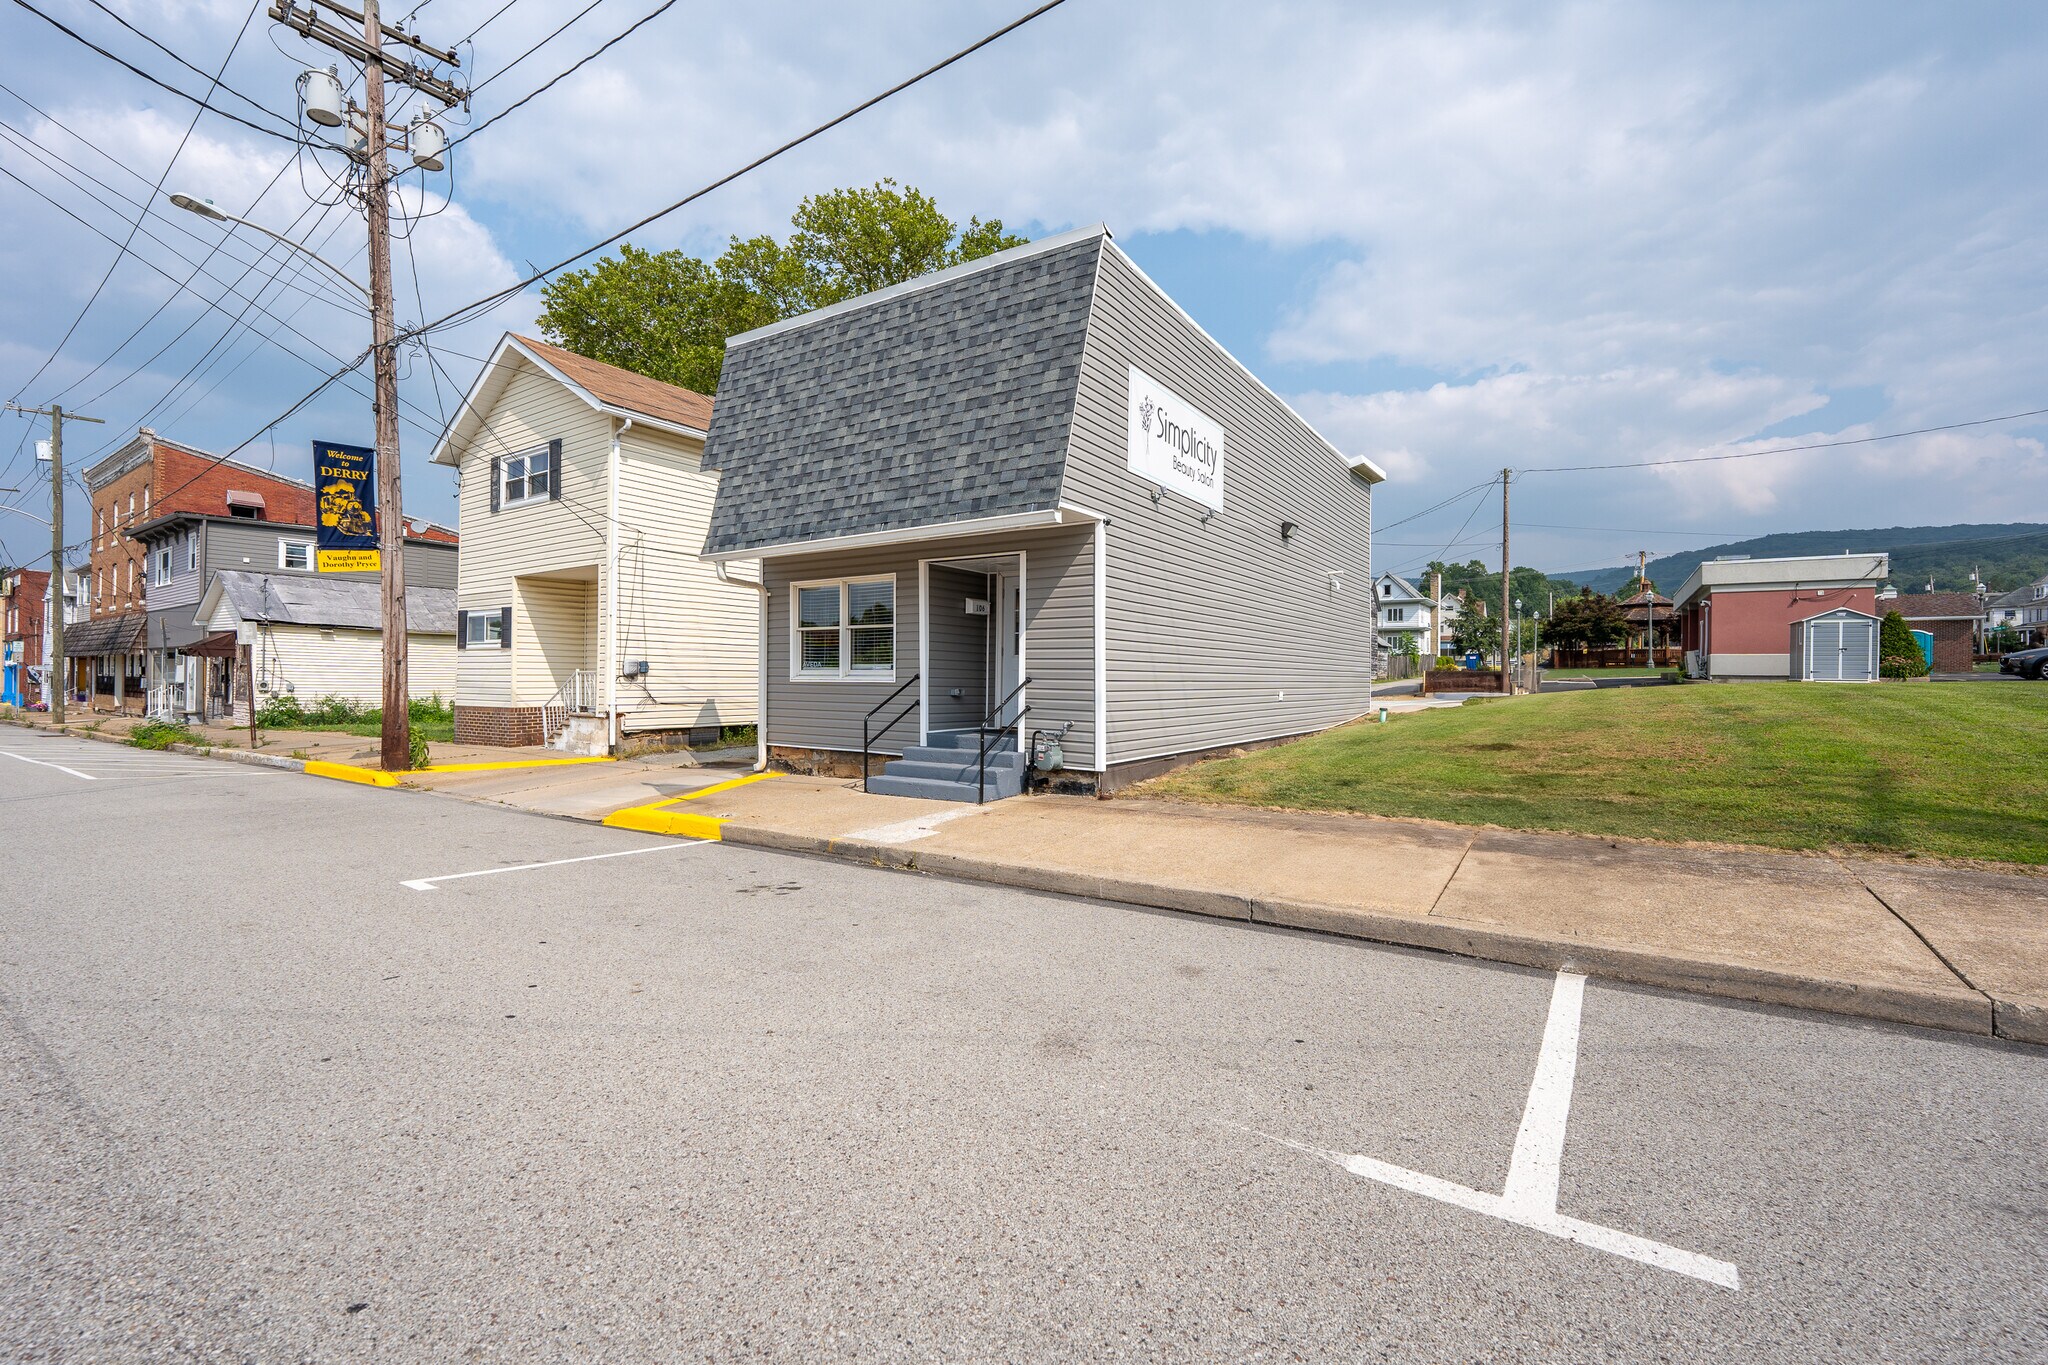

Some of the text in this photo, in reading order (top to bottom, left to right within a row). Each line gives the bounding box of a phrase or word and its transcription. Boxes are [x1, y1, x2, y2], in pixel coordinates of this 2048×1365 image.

[1156, 406, 1217, 476] Simplicity
[326, 449, 364, 462] Welcome
[320, 466, 369, 480] DERRY
[1172, 455, 1214, 489] Beauty Salon
[326, 554, 357, 562] Vaughn
[322, 561, 355, 569] Dorothy
[976, 604, 986, 612] 106
